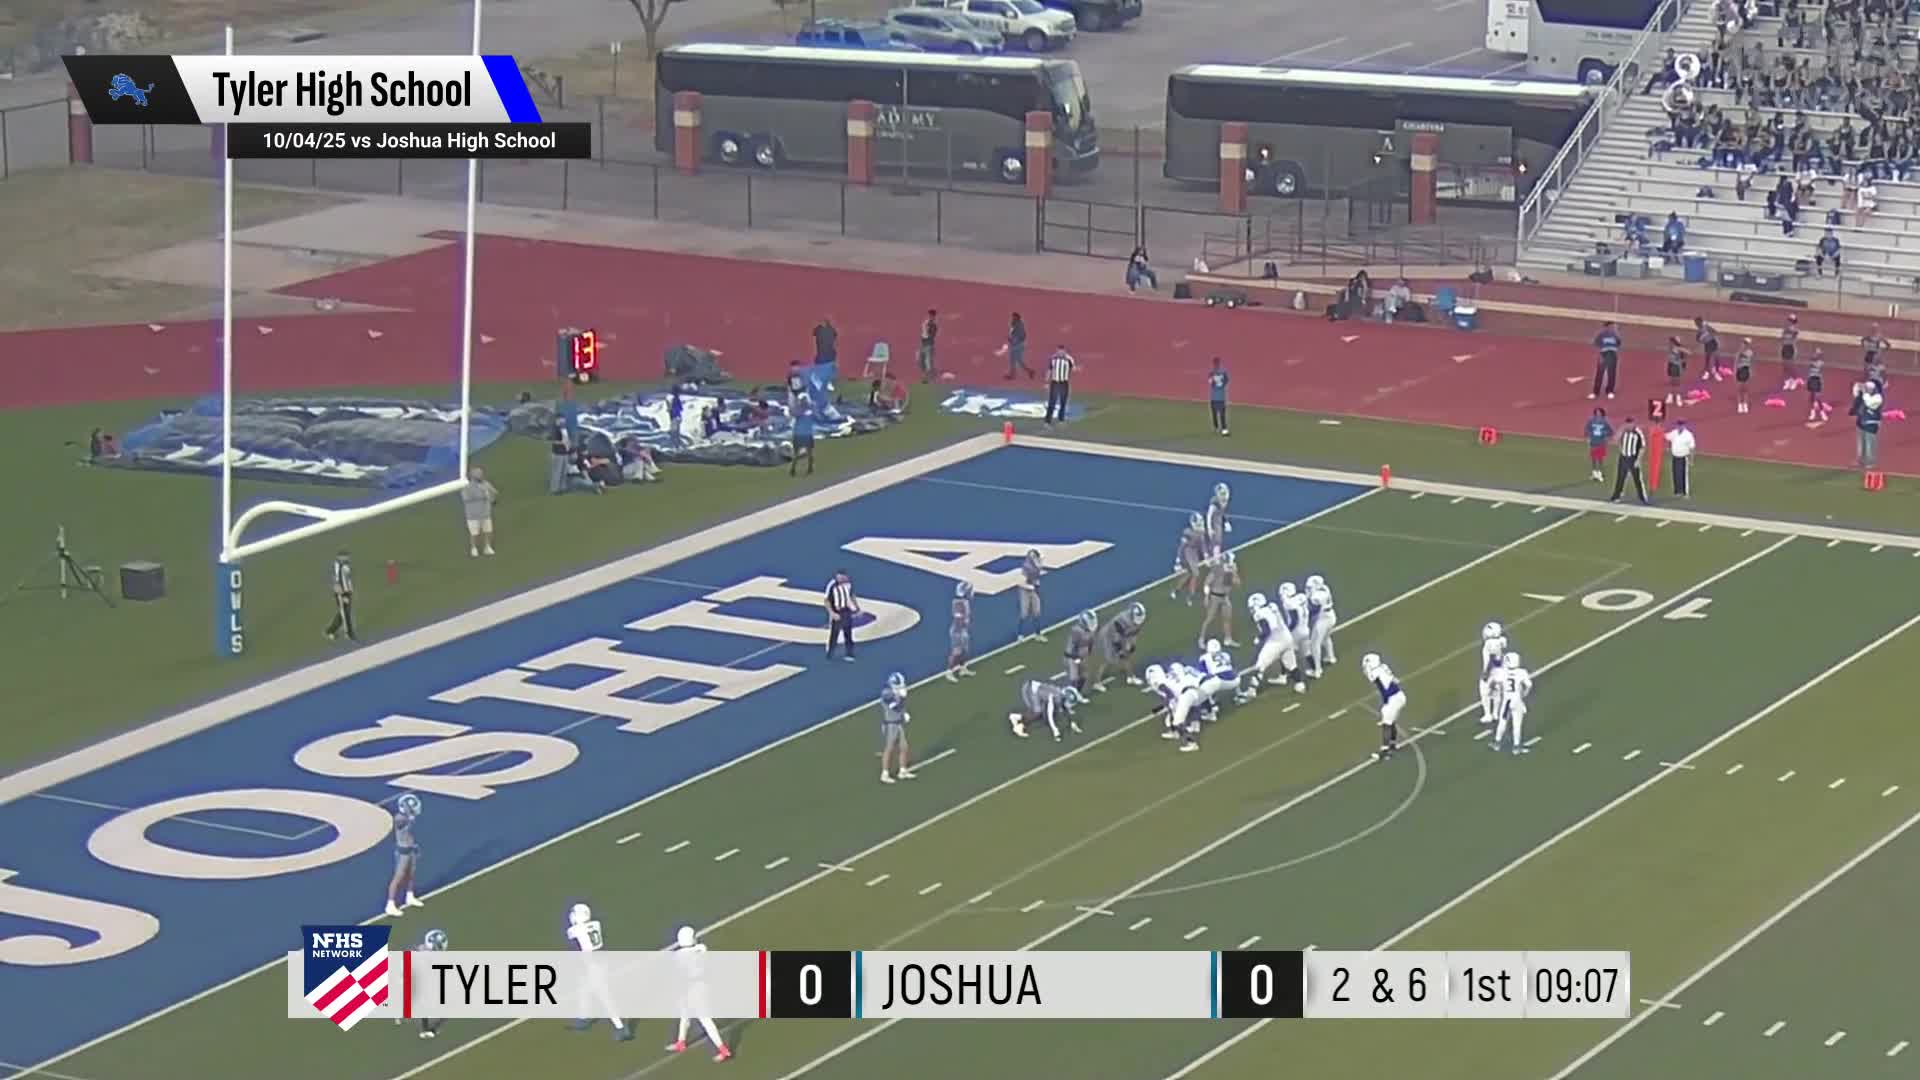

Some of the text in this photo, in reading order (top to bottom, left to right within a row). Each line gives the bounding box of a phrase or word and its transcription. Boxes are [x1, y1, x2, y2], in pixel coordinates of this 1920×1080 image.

[574, 331, 594, 369] 13
[1652, 400, 1663, 417] 2
[230, 570, 243, 653] OWLS
[0, 536, 1115, 966] JOSHUA
